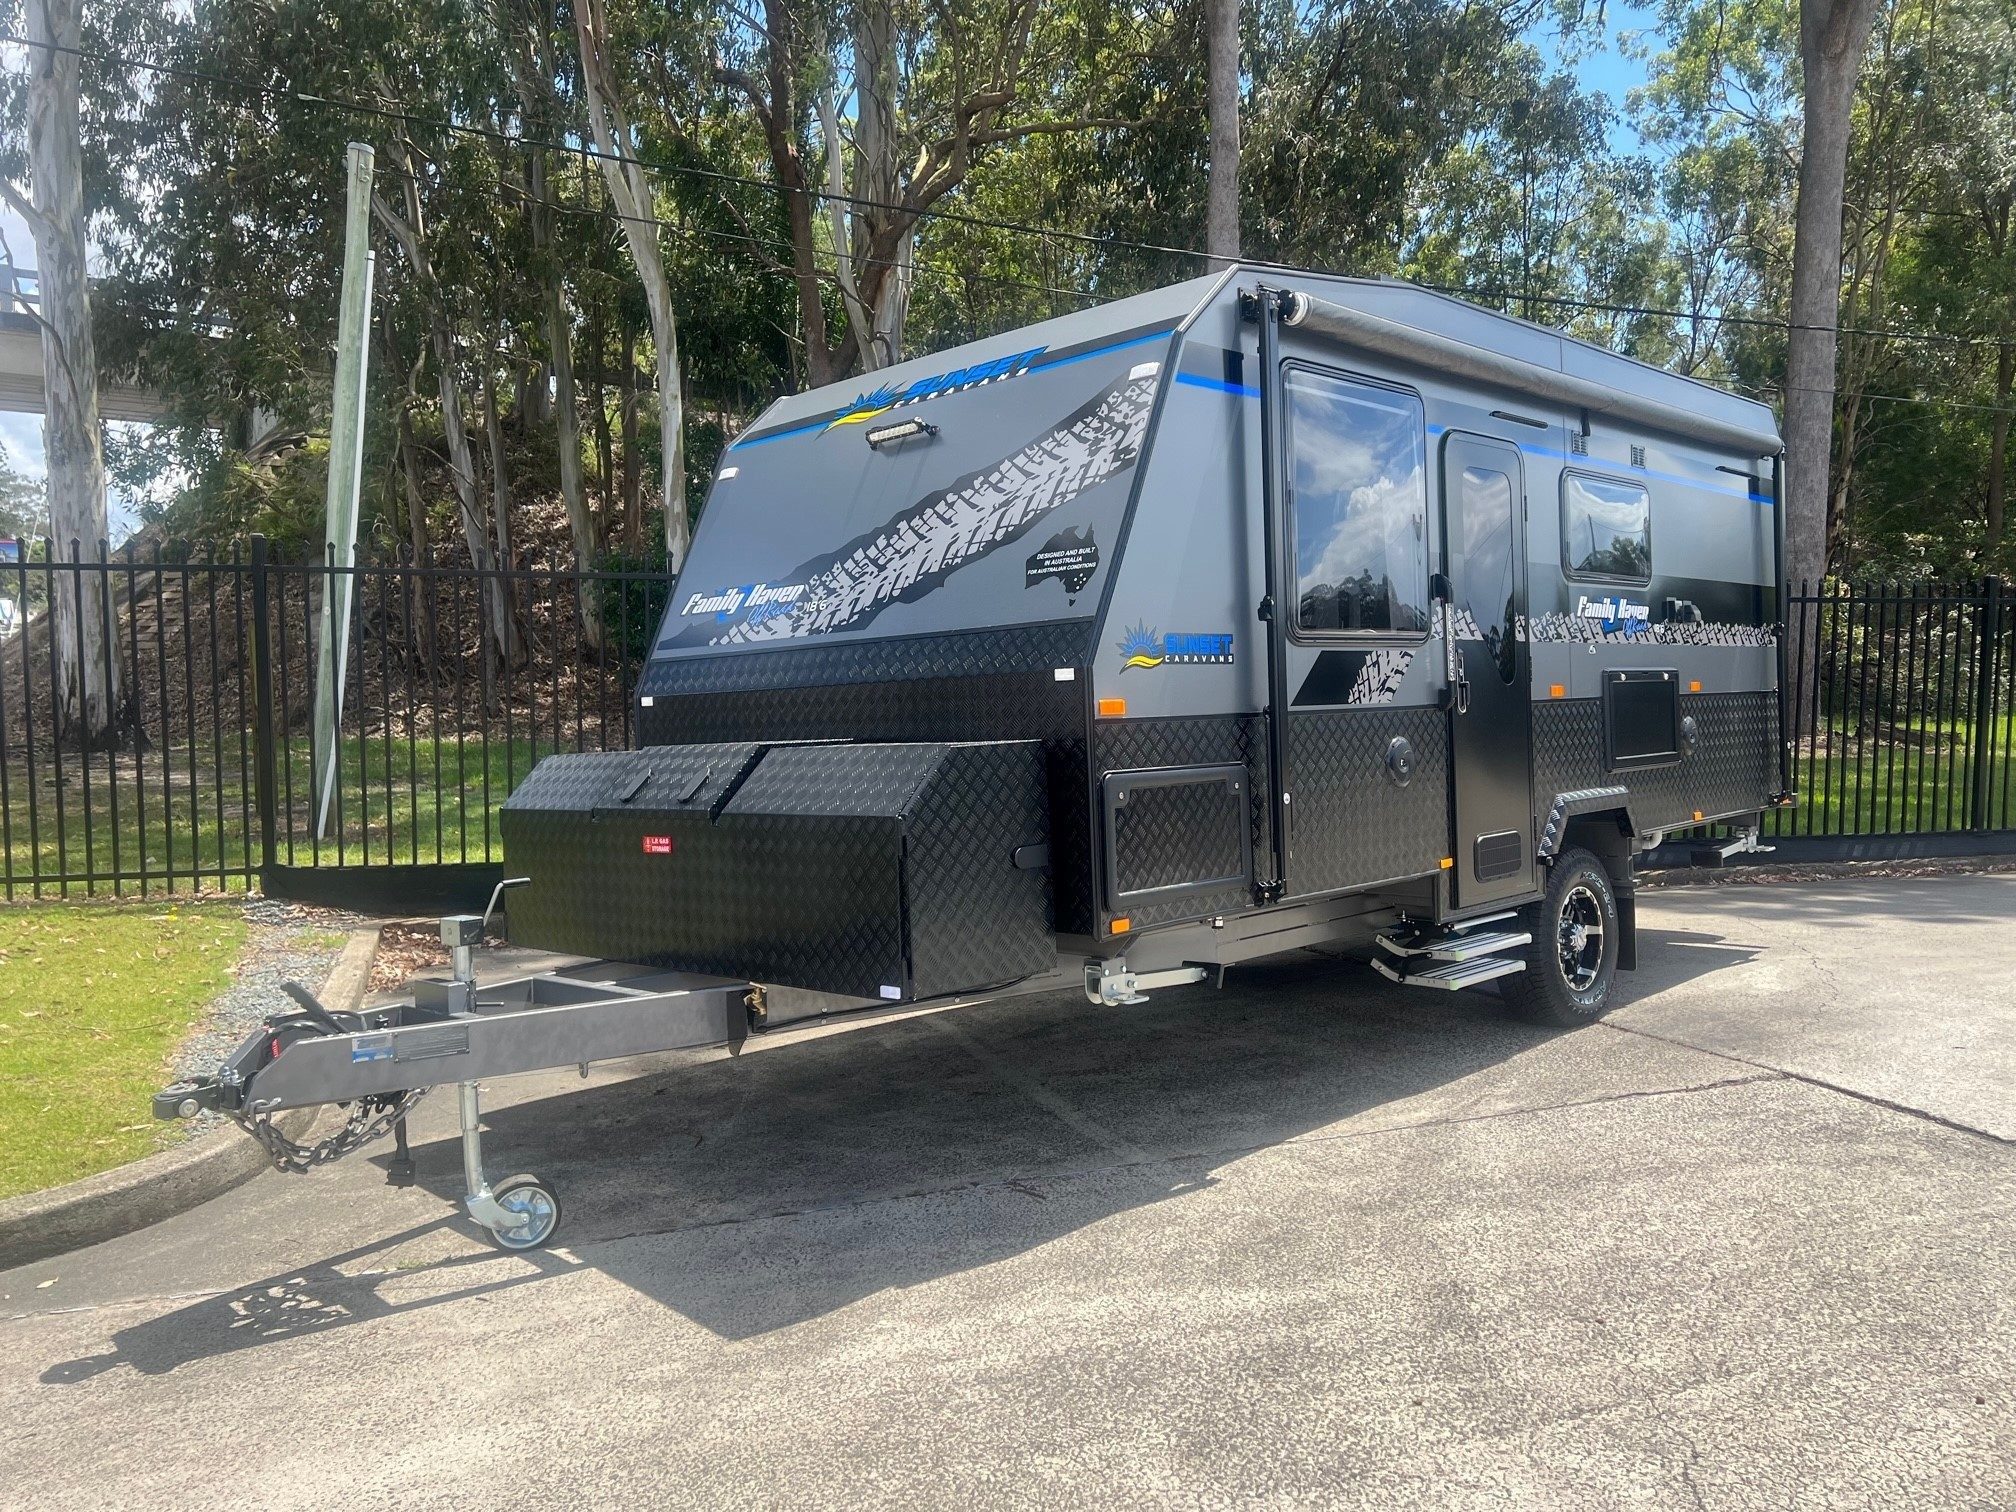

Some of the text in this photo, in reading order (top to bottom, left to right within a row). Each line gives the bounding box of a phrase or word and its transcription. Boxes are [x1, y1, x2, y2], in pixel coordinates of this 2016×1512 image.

[900, 345, 1049, 401] SUNSET
[893, 367, 1029, 409] CARAVANS
[1036, 546, 1096, 560] DESIGNED AND BUILT
[1051, 556, 1083, 565] AUSTRALIA
[1038, 565, 1067, 574] AUSTRALIAN
[1067, 562, 1097, 570] CONDITIONS
[680, 583, 805, 616] Family Haven
[1577, 595, 1650, 624] Family Haven
[1163, 633, 1233, 655] SUNSET
[1164, 655, 1233, 663] CARAVANS
